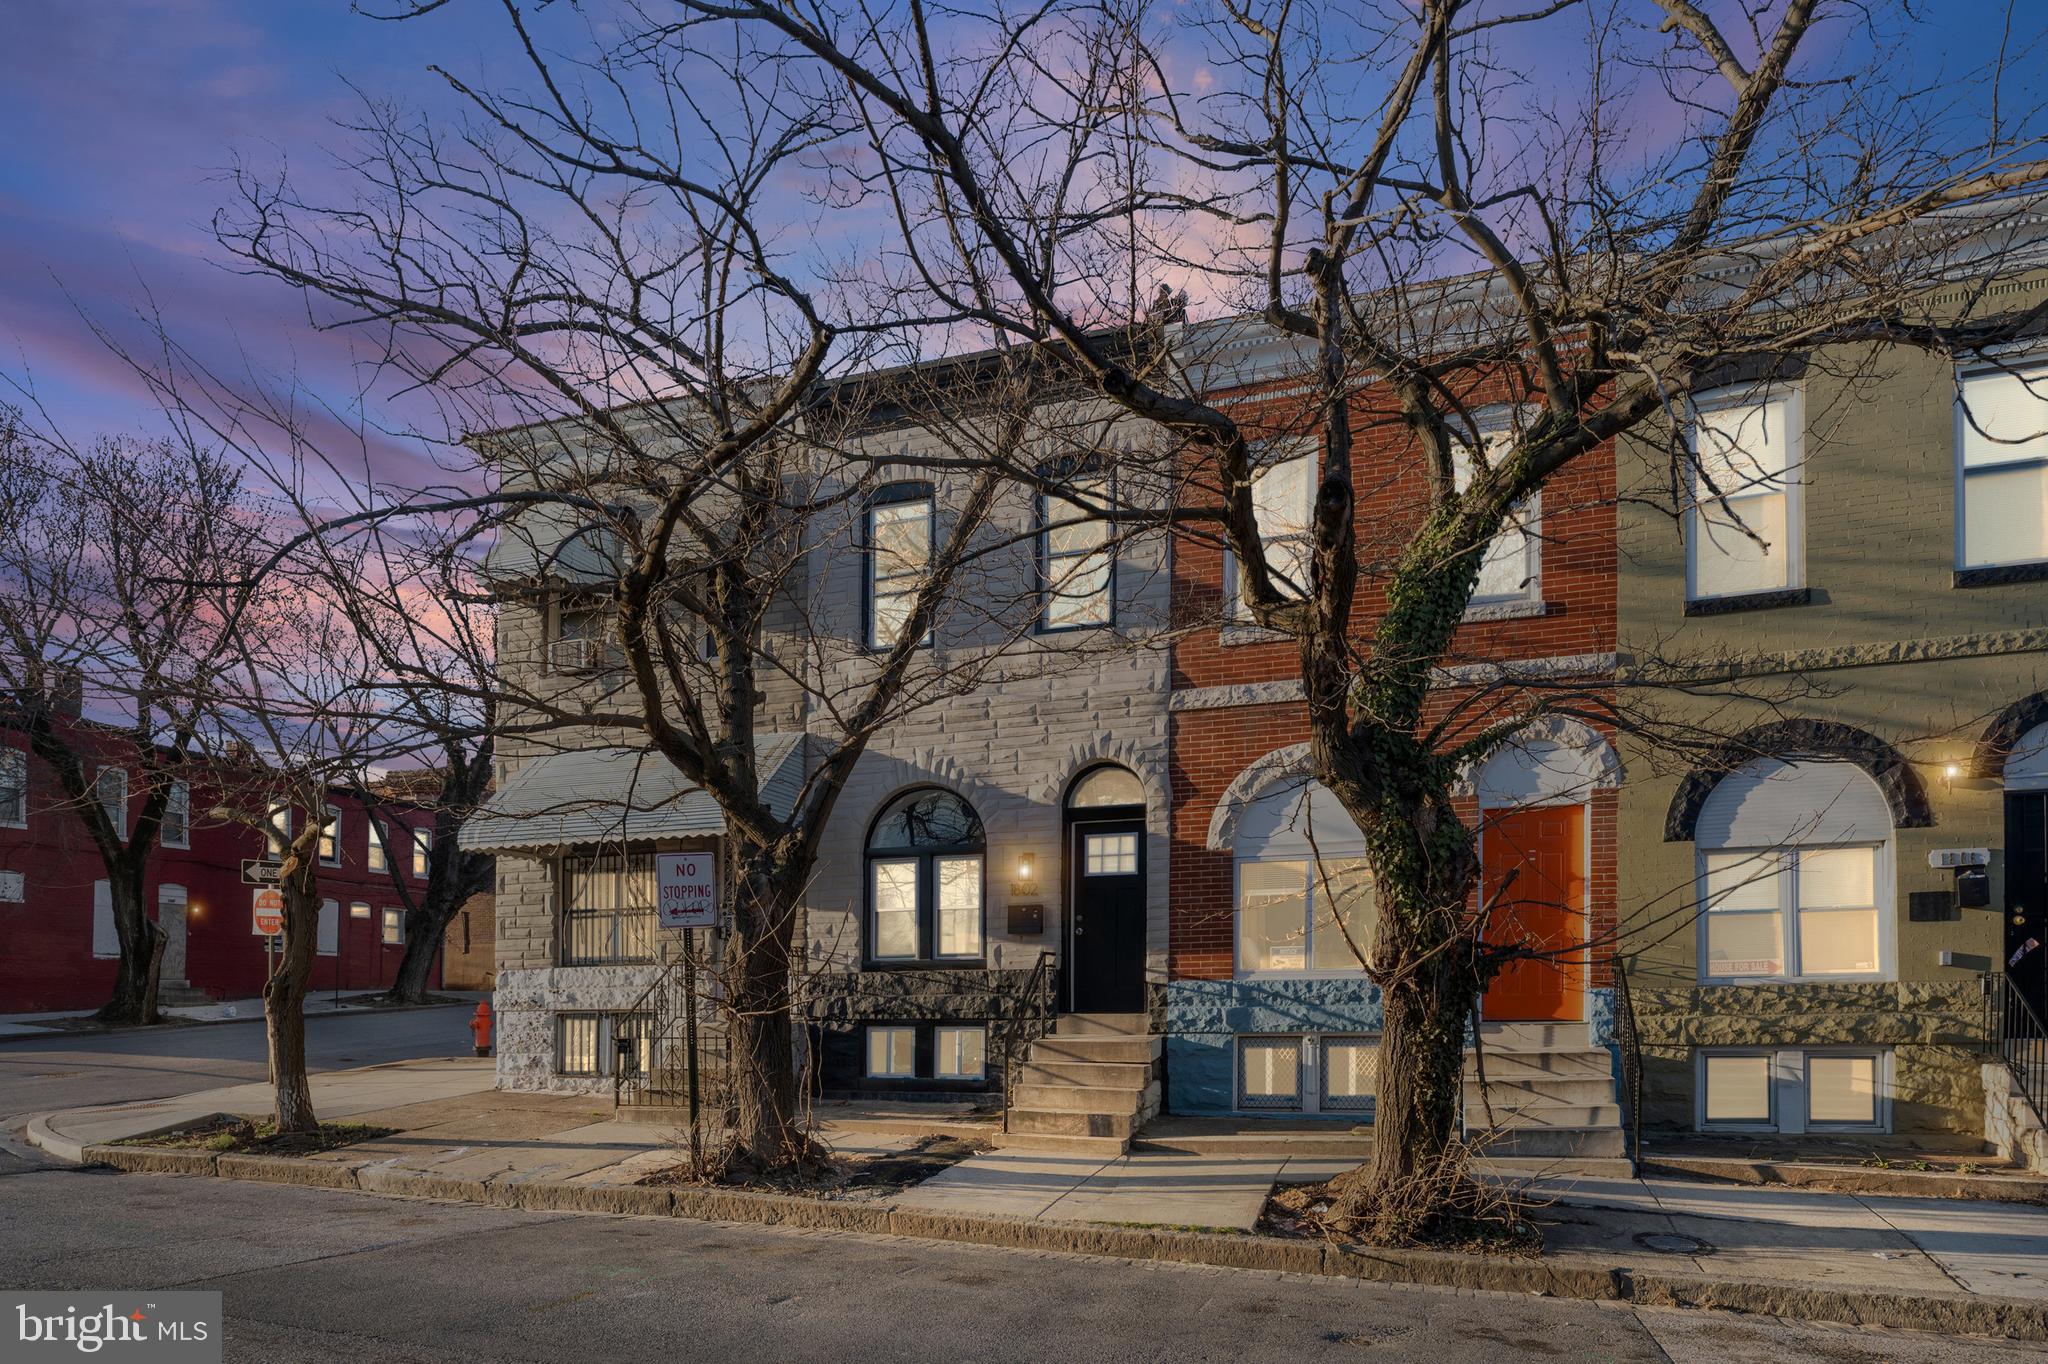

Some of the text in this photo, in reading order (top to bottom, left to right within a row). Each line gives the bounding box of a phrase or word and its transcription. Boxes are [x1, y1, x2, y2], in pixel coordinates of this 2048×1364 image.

[260, 868, 277, 878] ONE
[676, 863, 696, 877] NO
[663, 884, 711, 899] STOPPING
[258, 899, 267, 907] DO
[1709, 961, 1768, 971] HOUSE FOR SALE
